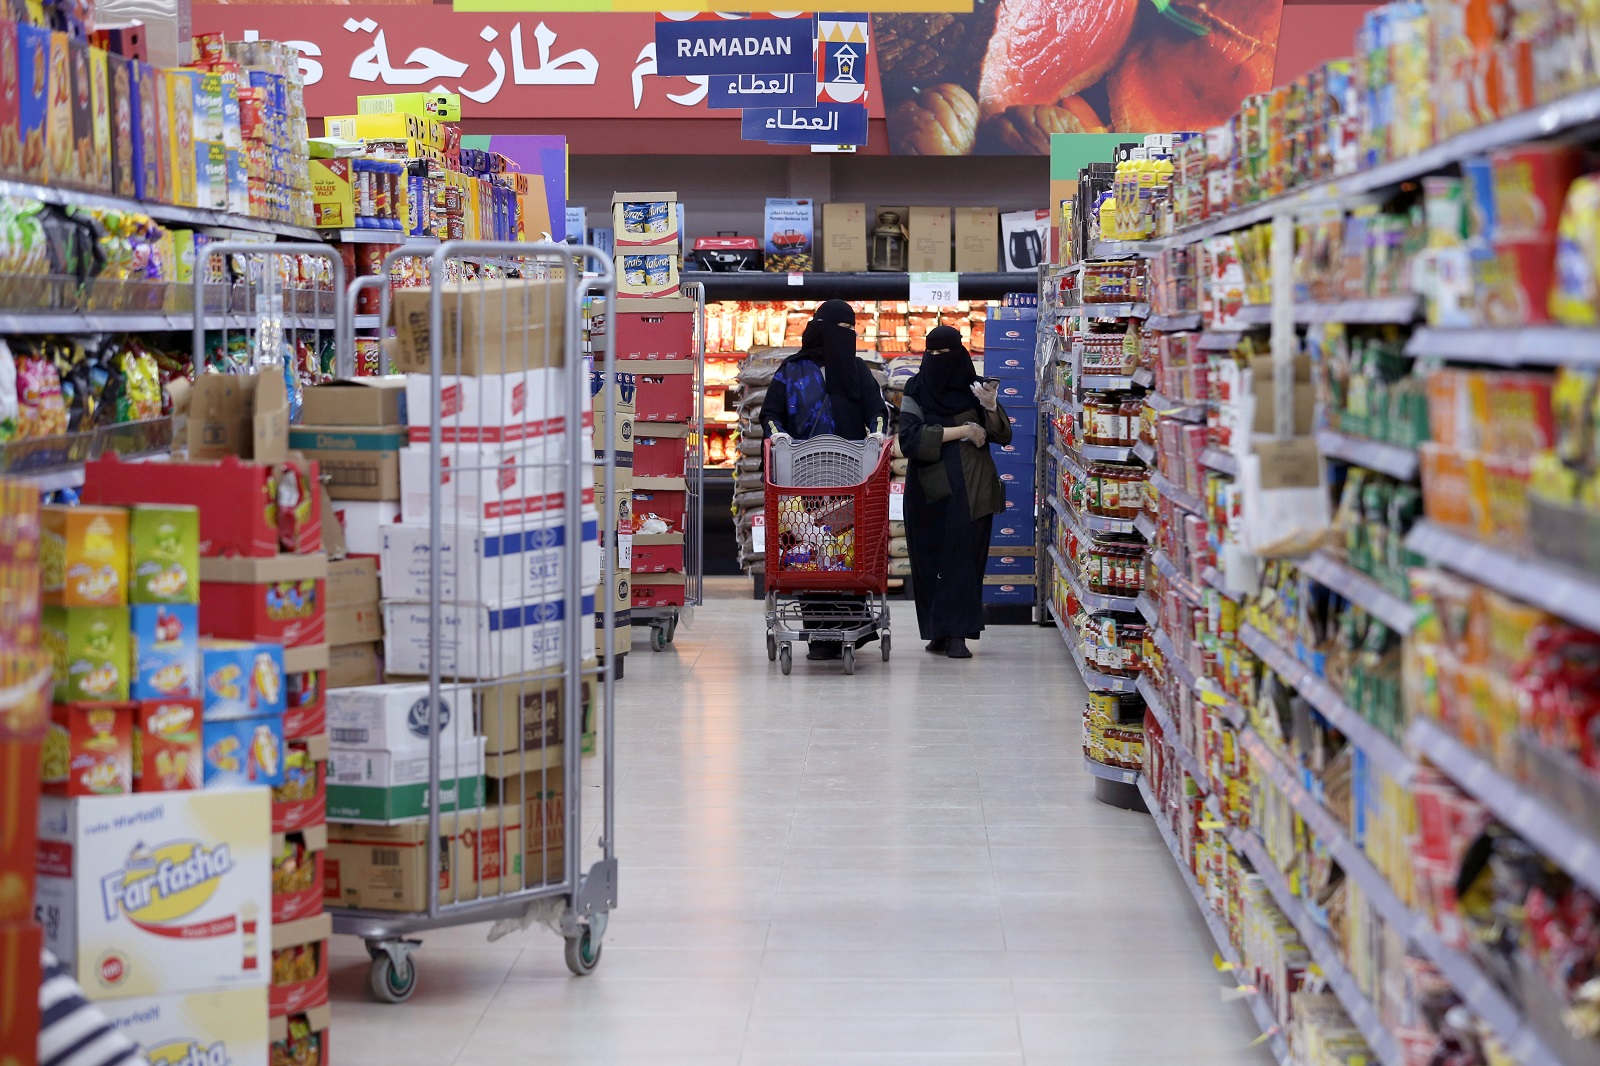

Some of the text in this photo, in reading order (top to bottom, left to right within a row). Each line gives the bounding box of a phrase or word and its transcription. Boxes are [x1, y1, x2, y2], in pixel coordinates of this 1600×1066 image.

[677, 36, 792, 58] RAMADAN
[765, 109, 839, 131] العطاء
[931, 290, 943, 300] 79
[317, 433, 357, 449] Dilmah
[529, 562, 559, 581] SALT
[100, 842, 233, 923] Farfasha
